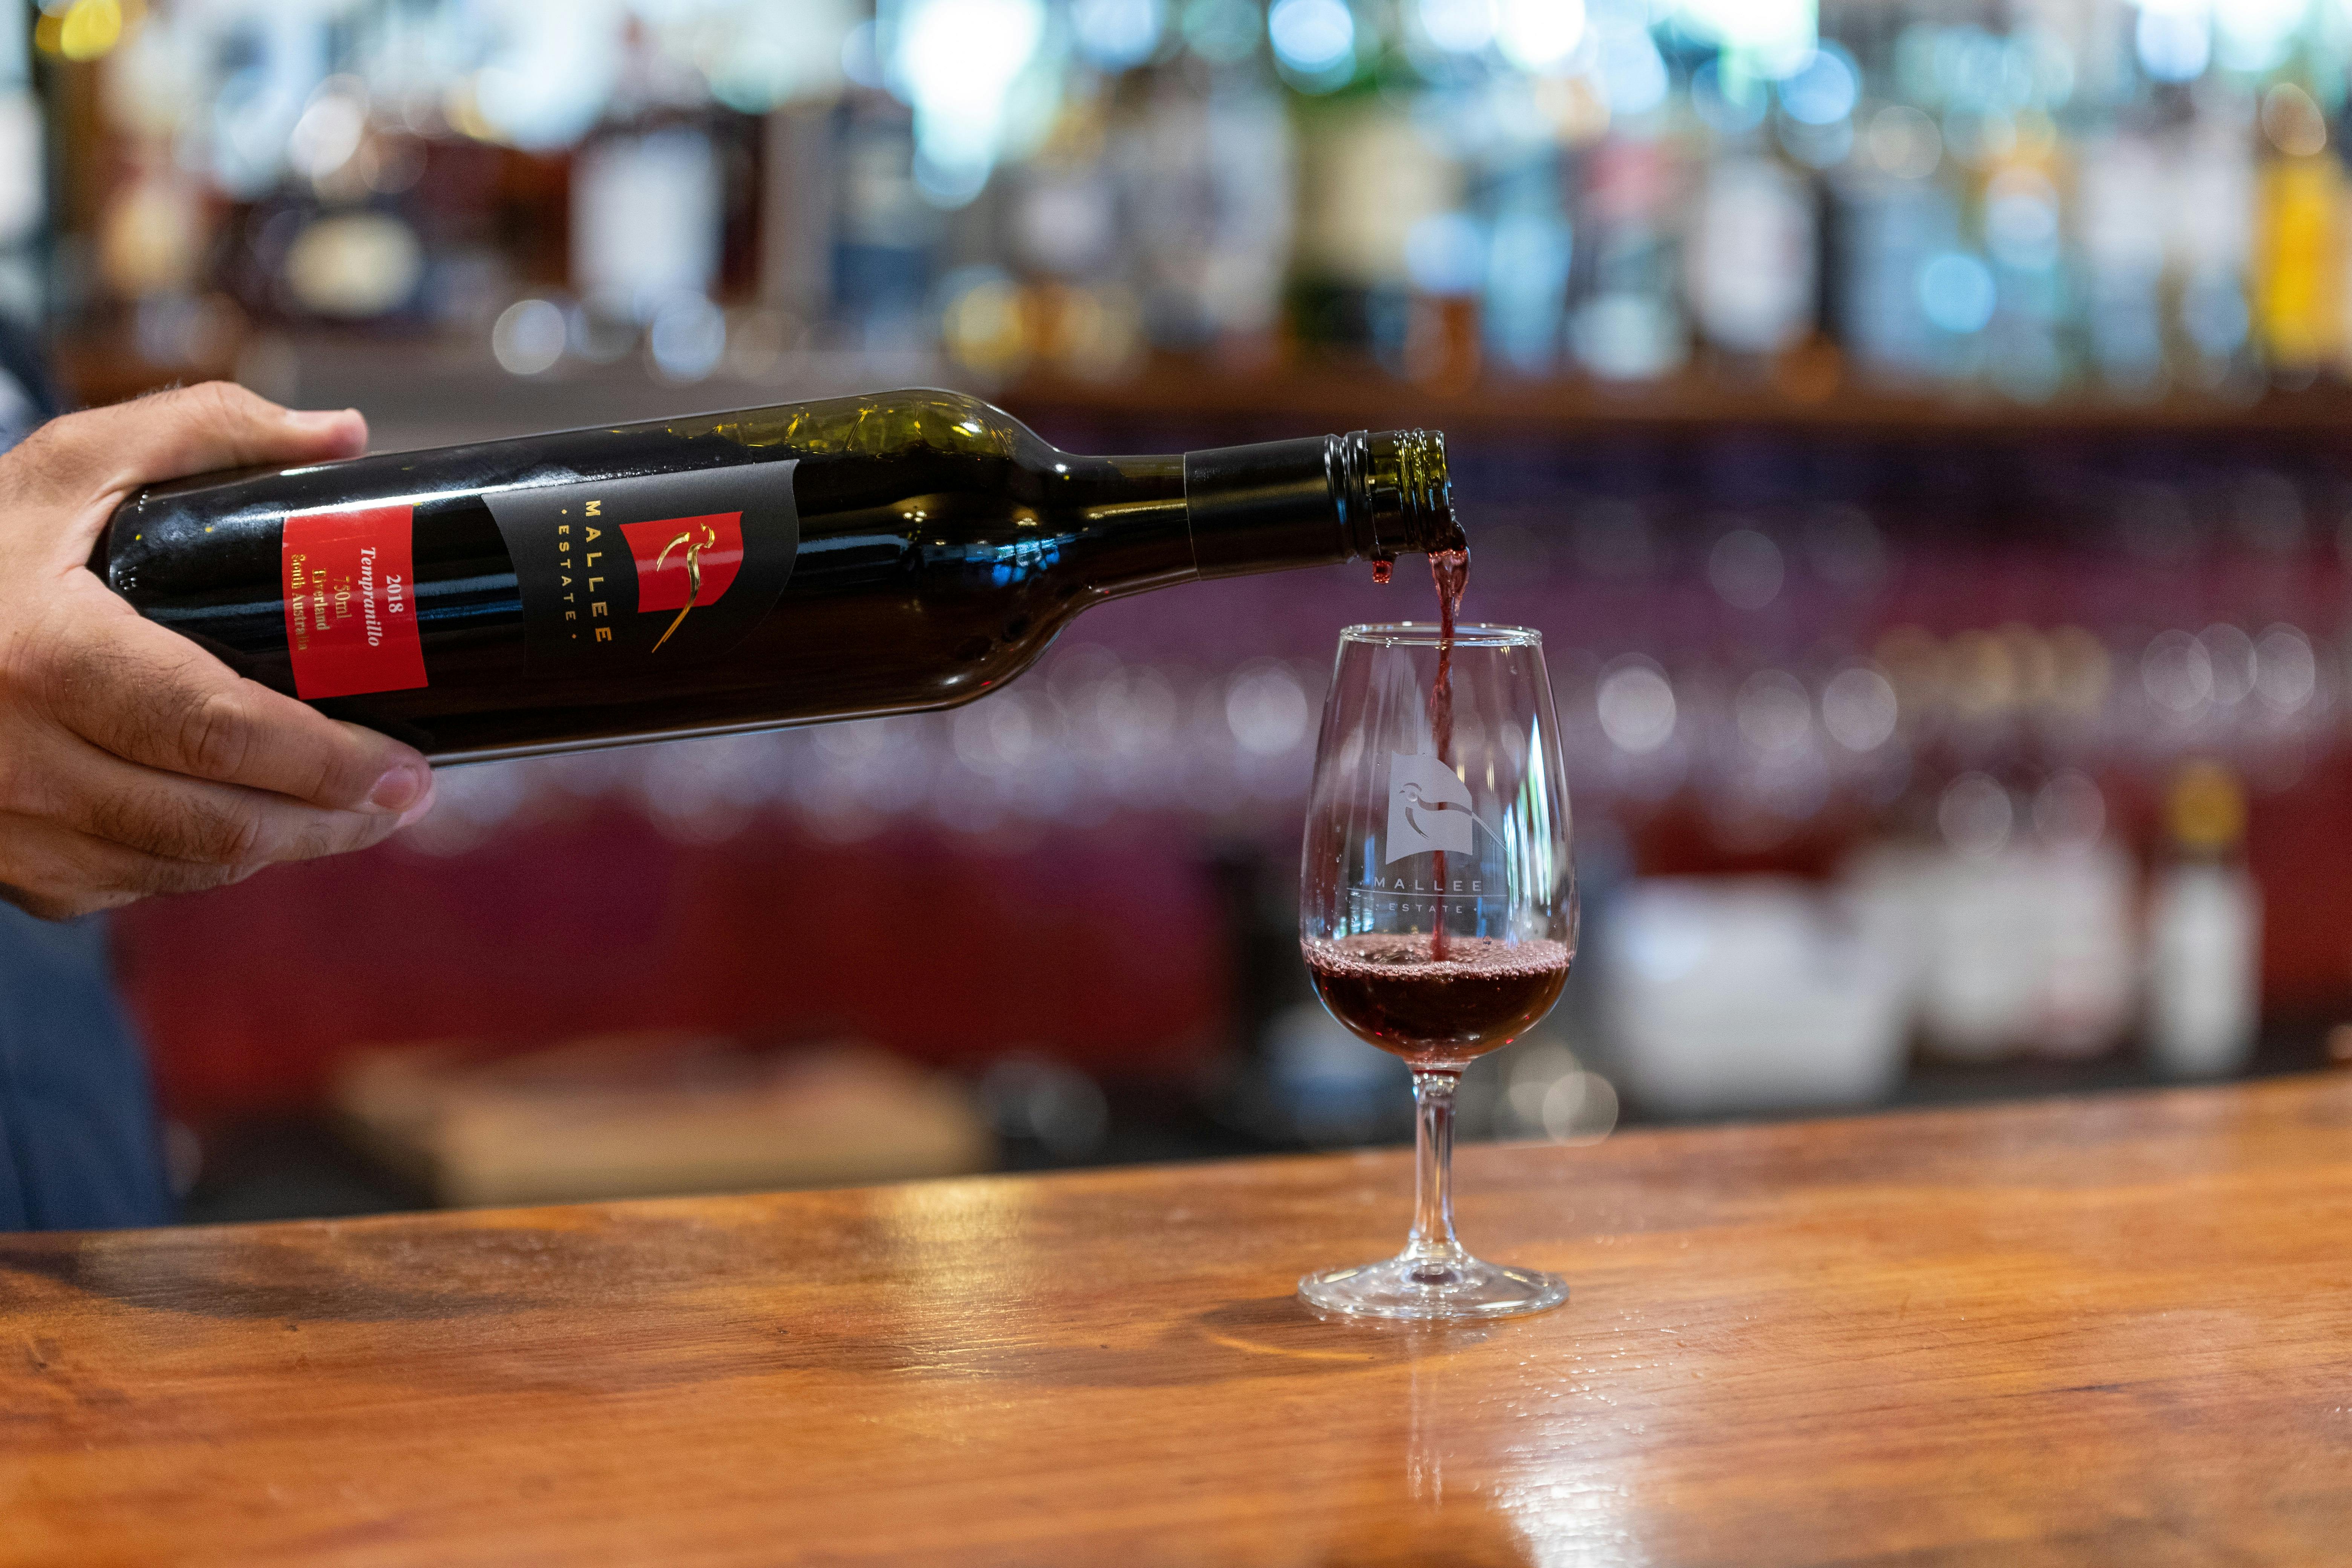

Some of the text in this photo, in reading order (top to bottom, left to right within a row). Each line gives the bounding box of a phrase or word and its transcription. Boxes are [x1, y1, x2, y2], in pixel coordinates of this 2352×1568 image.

[291, 554, 309, 651] South Australia
[334, 576, 352, 619] 750ml
[358, 547, 383, 646] Tempranillo
[386, 574, 403, 613] 2018
[558, 525, 576, 621] ESTATE
[585, 500, 612, 642] MALLEE
[1374, 877, 1482, 891] MALLEE
[1389, 903, 1462, 914] ESTATE
